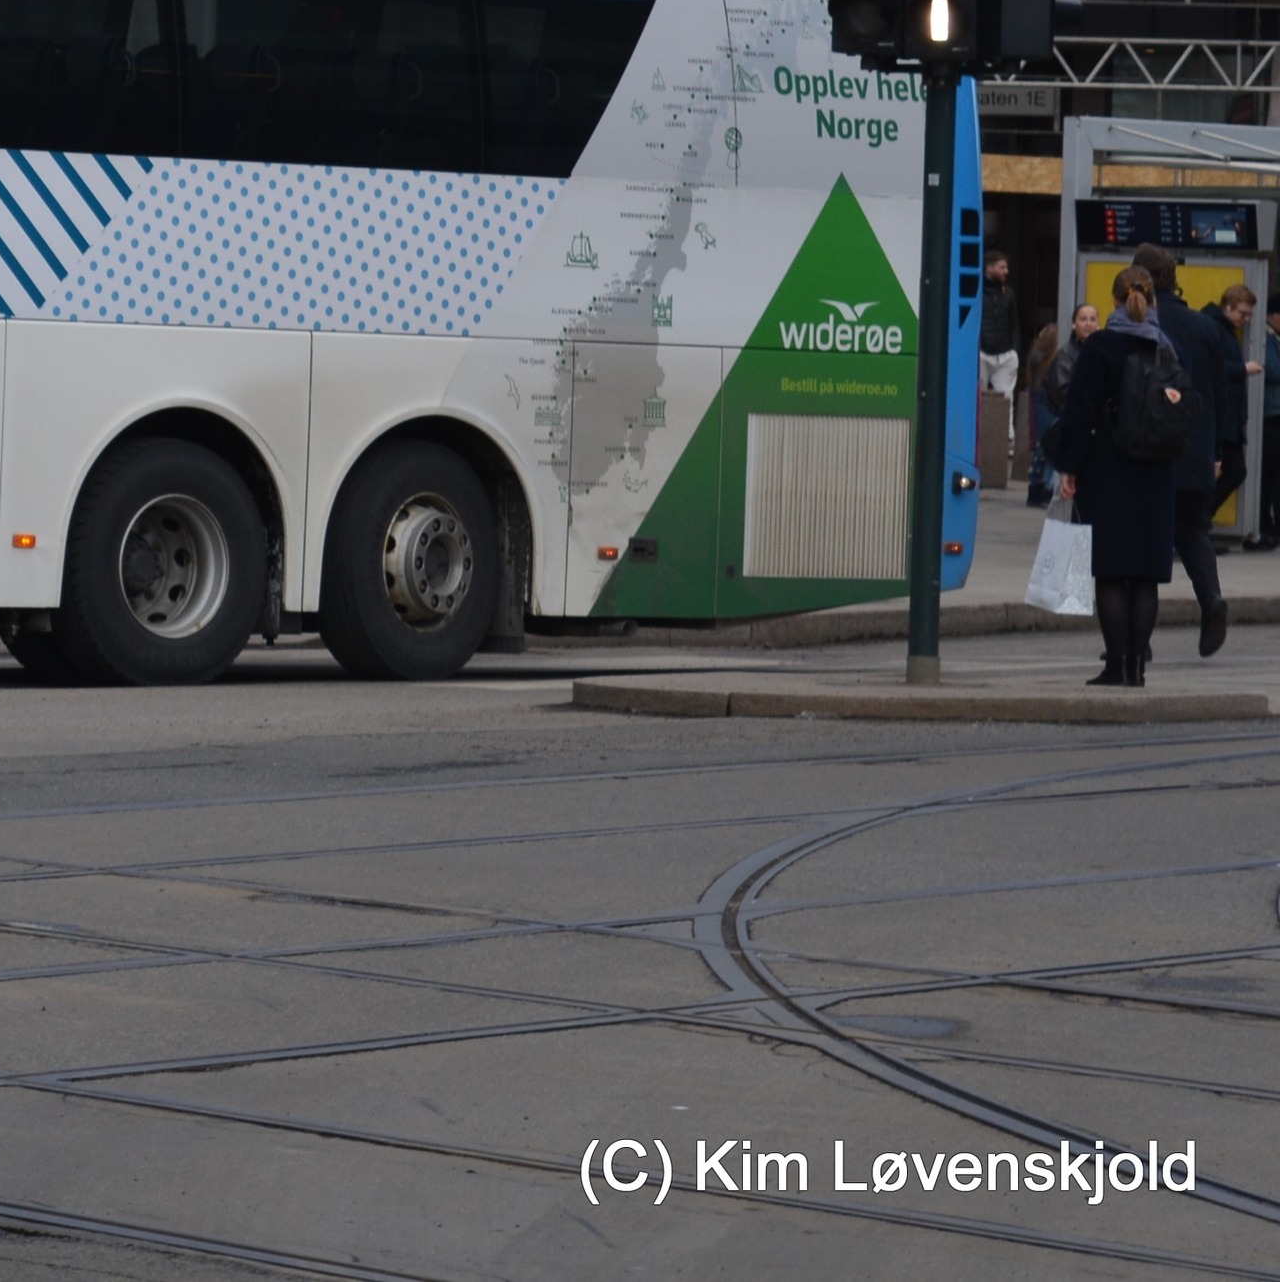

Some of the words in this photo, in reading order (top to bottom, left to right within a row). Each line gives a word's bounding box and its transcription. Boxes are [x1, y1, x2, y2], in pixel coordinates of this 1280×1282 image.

[774, 66, 868, 104] Opplev
[816, 109, 898, 148] Norge
[779, 313, 903, 354] widerøe
[781, 377, 817, 392] Bestill
[820, 378, 834, 396] på
